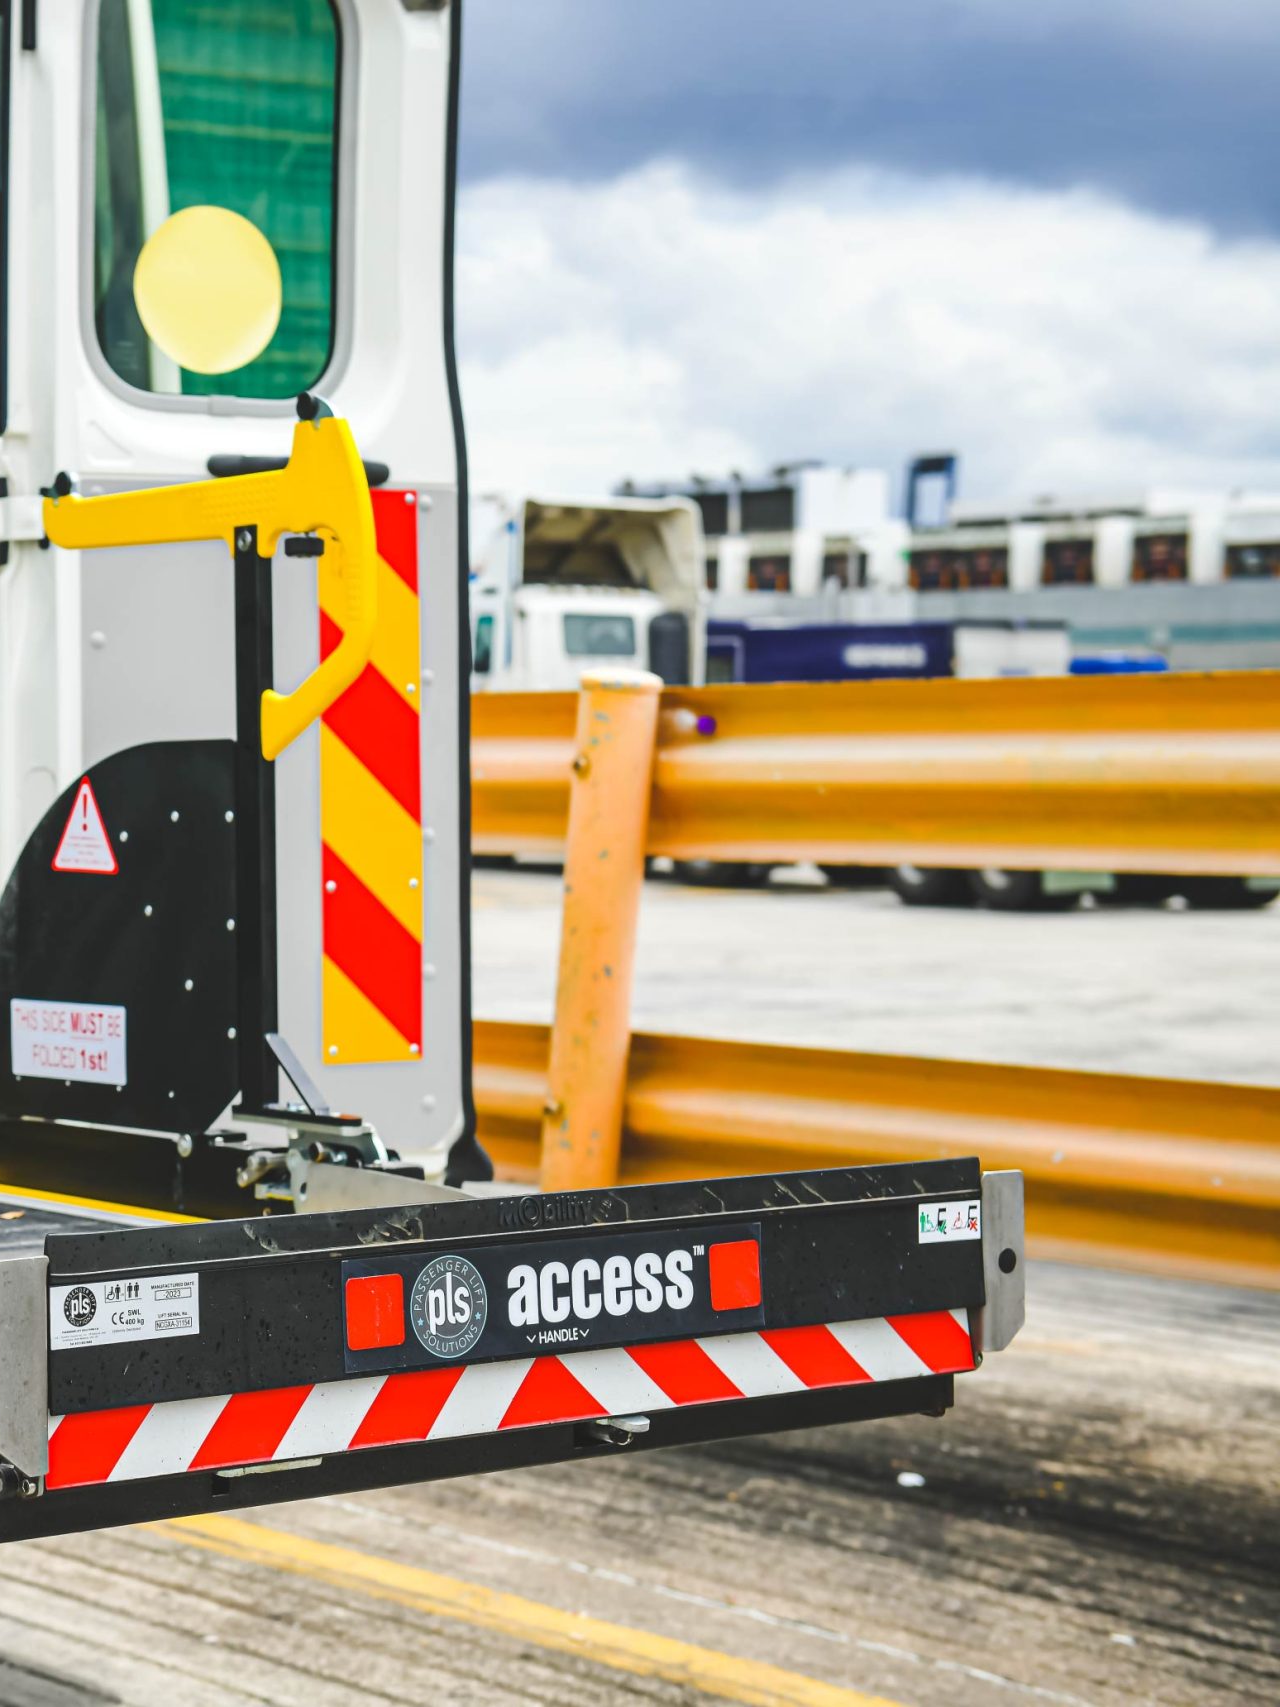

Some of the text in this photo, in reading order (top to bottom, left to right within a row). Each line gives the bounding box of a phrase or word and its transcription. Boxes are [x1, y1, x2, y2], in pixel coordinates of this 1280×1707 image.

[15, 1007, 122, 1037] THIS SIDE MUST BE
[32, 1043, 108, 1072] FOLDED 1st!
[413, 1260, 484, 1311] PASSENGER LIFT
[71, 1292, 91, 1318] pls
[428, 1272, 471, 1335] pls
[423, 1324, 478, 1353] SOLUTIONS
[539, 1327, 578, 1344] HANDLE
